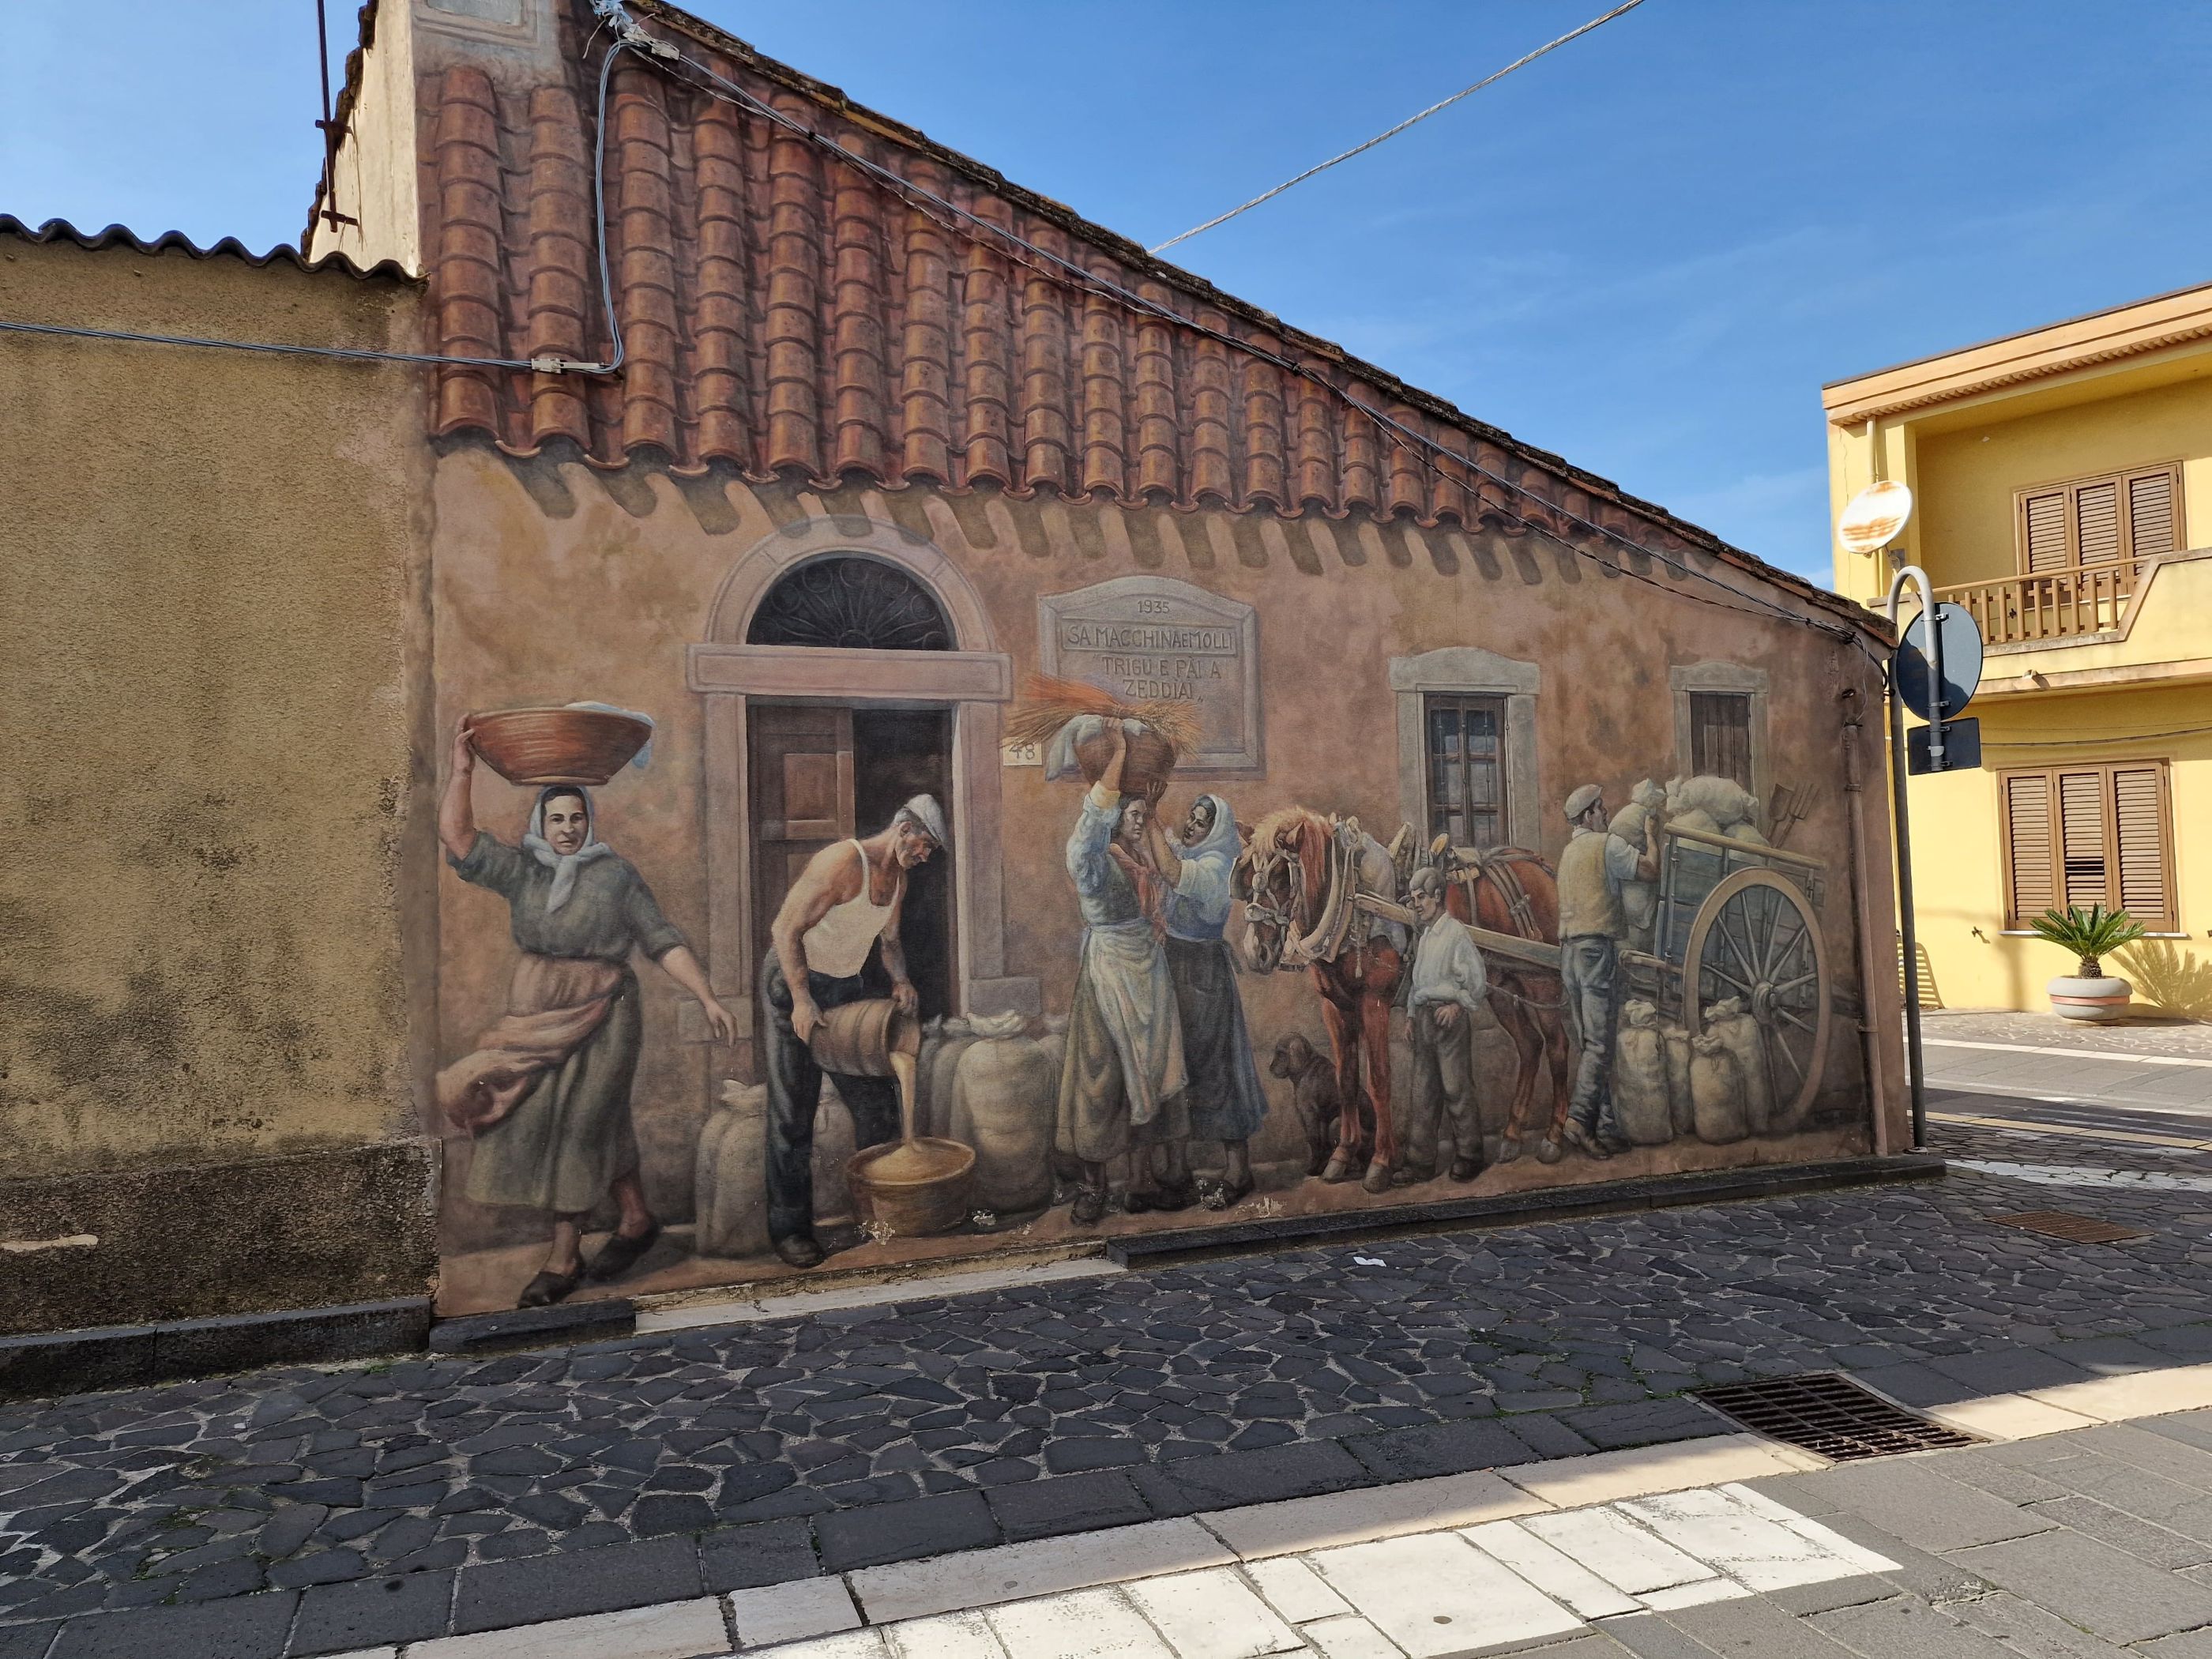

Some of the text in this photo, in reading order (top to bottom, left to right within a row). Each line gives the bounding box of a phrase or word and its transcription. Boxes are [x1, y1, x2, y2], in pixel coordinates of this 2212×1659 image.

[1138, 600, 1170, 614] 1935
[1067, 625, 1091, 646] SA
[1159, 660, 1169, 676] E
[1209, 660, 1222, 679] A
[1009, 740, 1035, 760] 48
